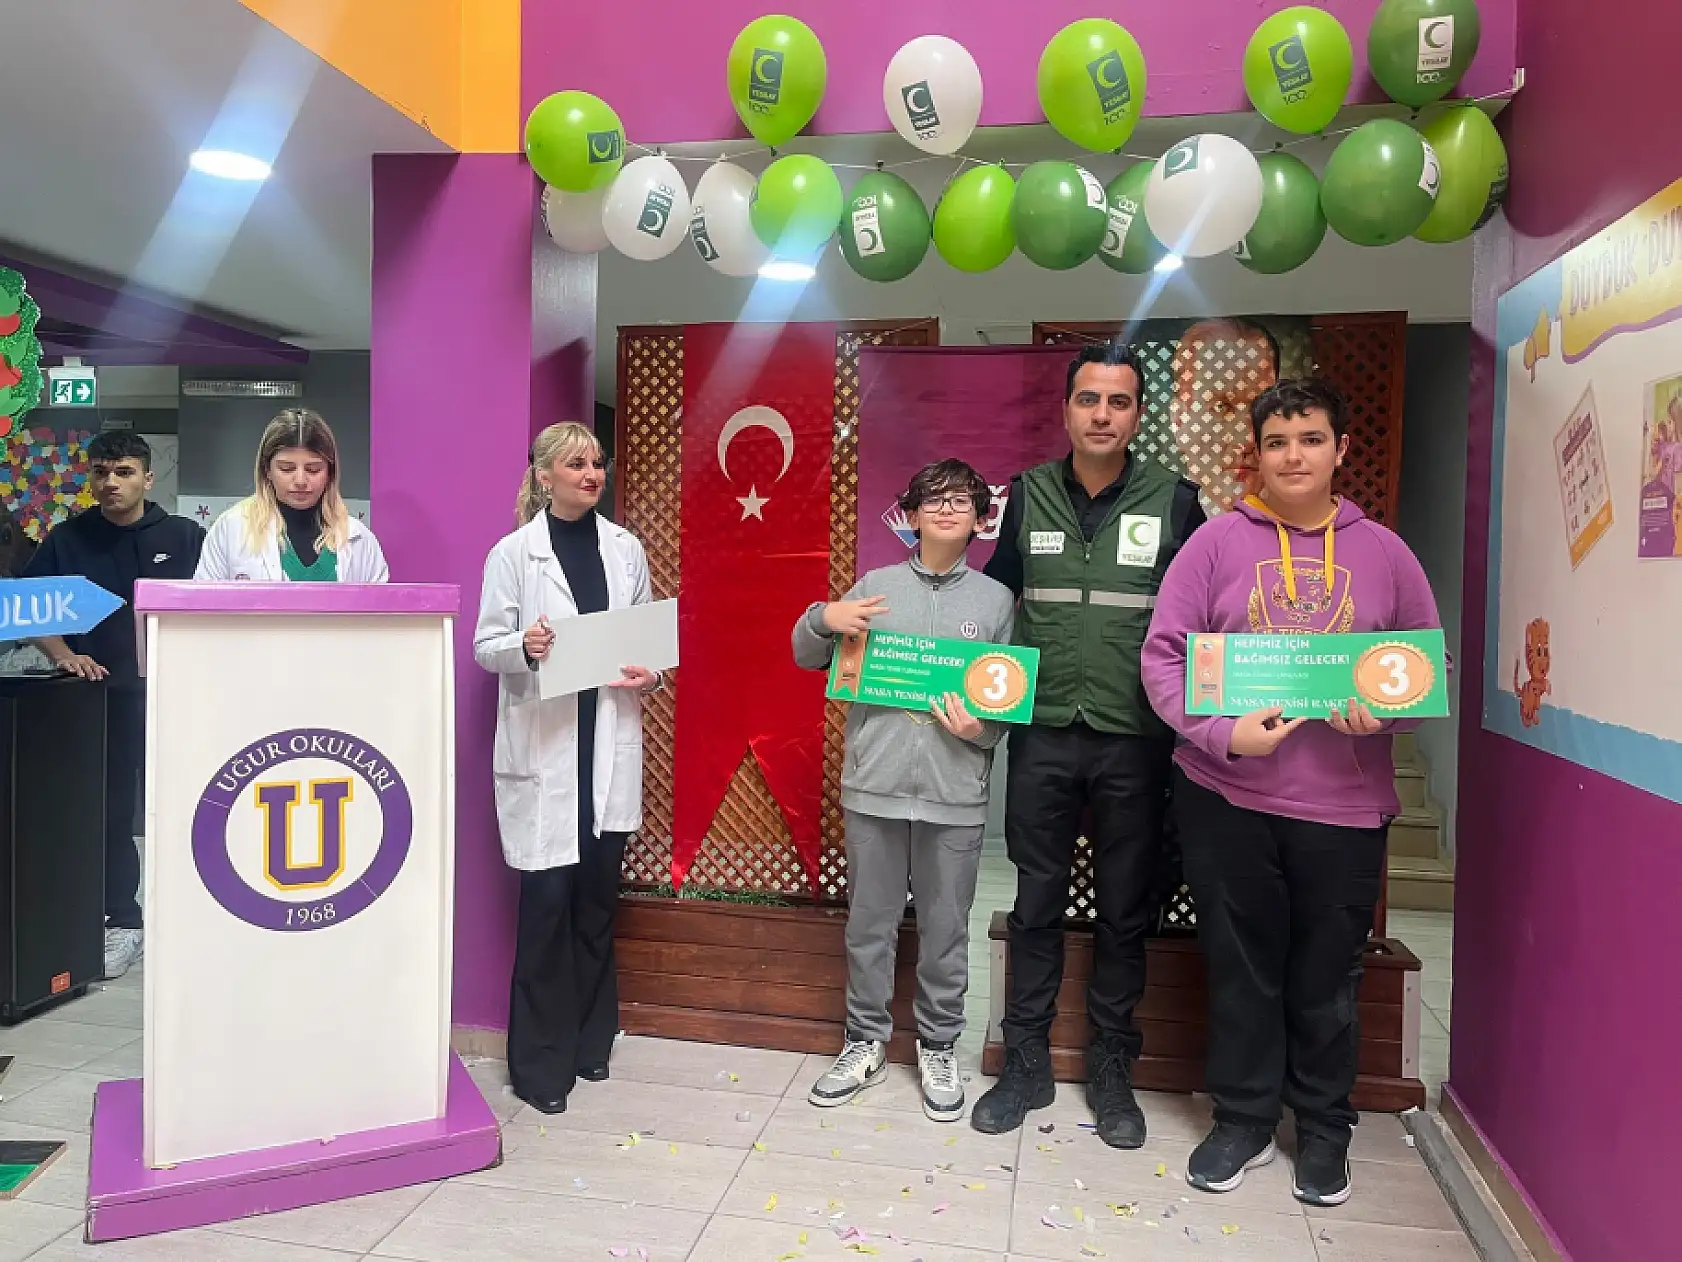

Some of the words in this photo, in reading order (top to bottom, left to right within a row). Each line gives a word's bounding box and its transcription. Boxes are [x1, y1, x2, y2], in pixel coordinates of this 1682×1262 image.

[983, 663, 1008, 700] 3
[1377, 653, 1410, 696] 3
[216, 741, 287, 792] UĞUR
[290, 735, 397, 792] OKULLARI
[254, 776, 353, 891] U
[286, 903, 336, 926] 1968
